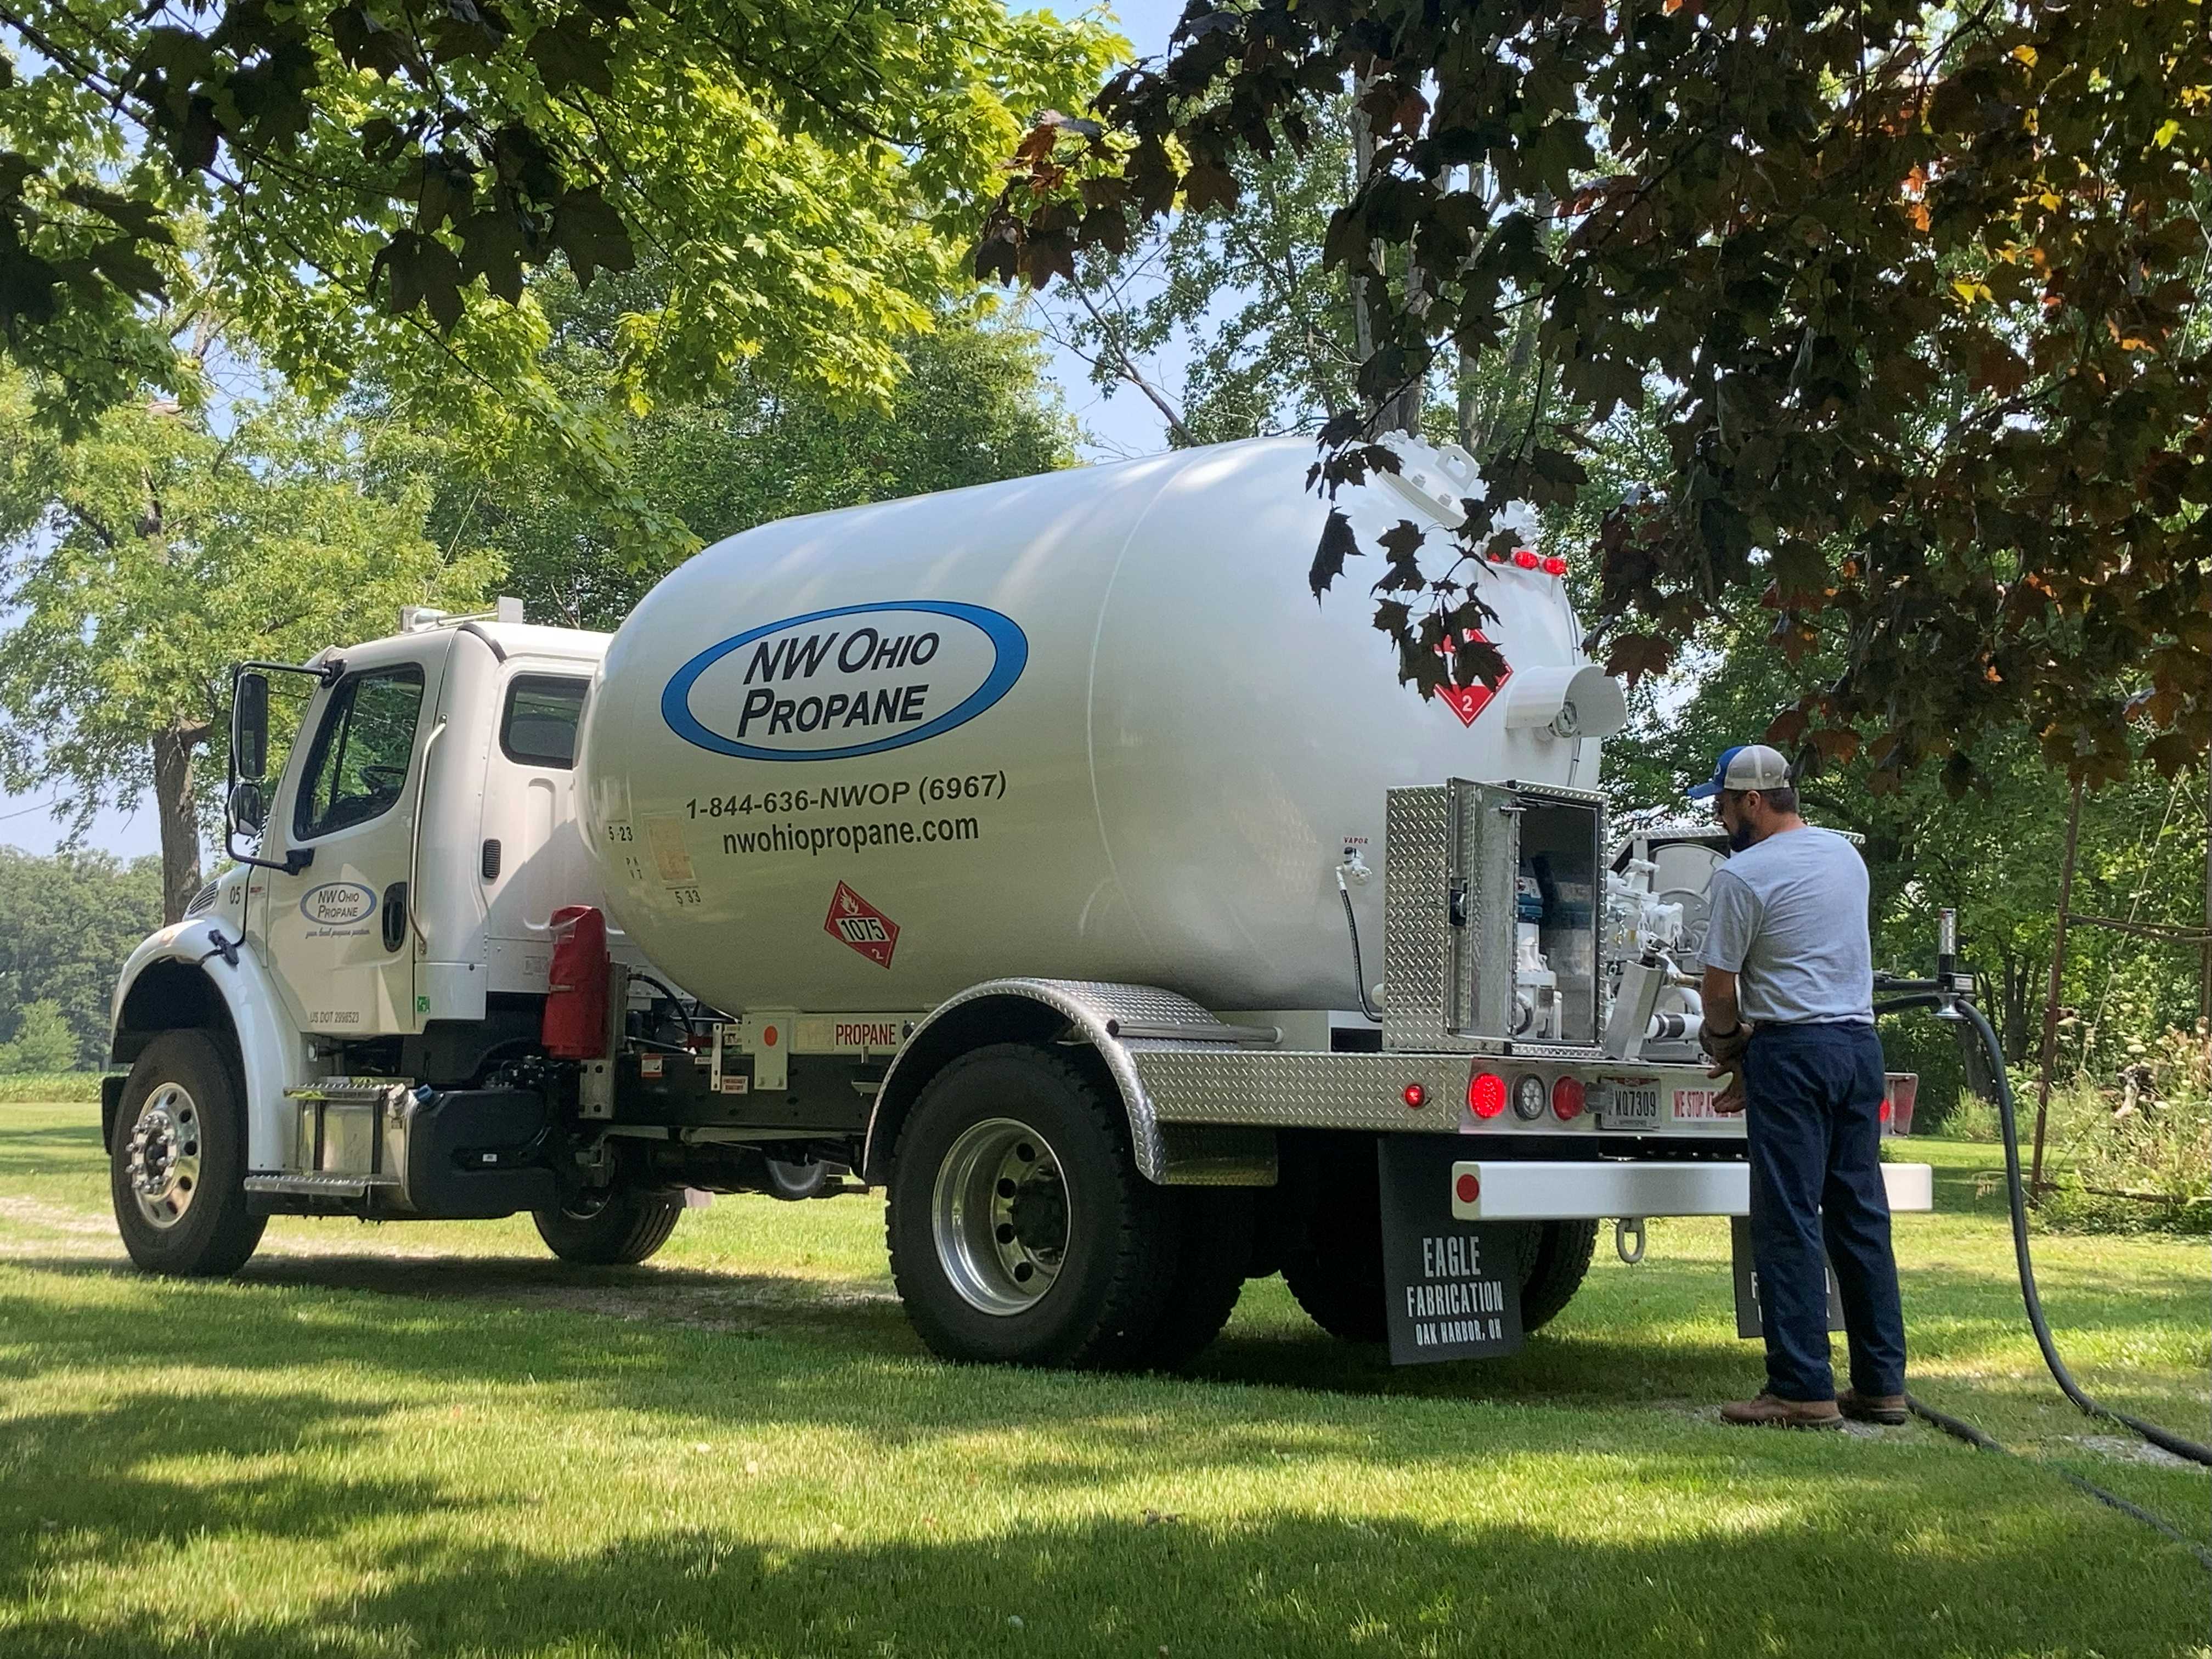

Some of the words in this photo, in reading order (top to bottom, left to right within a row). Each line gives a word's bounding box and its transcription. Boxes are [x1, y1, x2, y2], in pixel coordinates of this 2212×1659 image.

[743, 631, 840, 685] NW
[1462, 695, 1473, 712] 2
[686, 781, 911, 820] 1-844-636-NWOP
[918, 770, 1007, 805] (6967)
[723, 816, 979, 857] nwohiopropane.com
[229, 885, 241, 905] 05
[318, 889, 337, 904] NW
[840, 919, 886, 941] 1075
[871, 947, 884, 960] 2
[320, 1011, 334, 1023] DOT
[836, 1023, 897, 1046] PROPANE
[1422, 1235, 1482, 1278] EAGLE
[1406, 1280, 1504, 1318] FABRICATION
[1415, 1323, 1438, 1346] OAK
[1440, 1319, 1486, 1344] HARBOR,
[1488, 1318, 1503, 1340] OH
